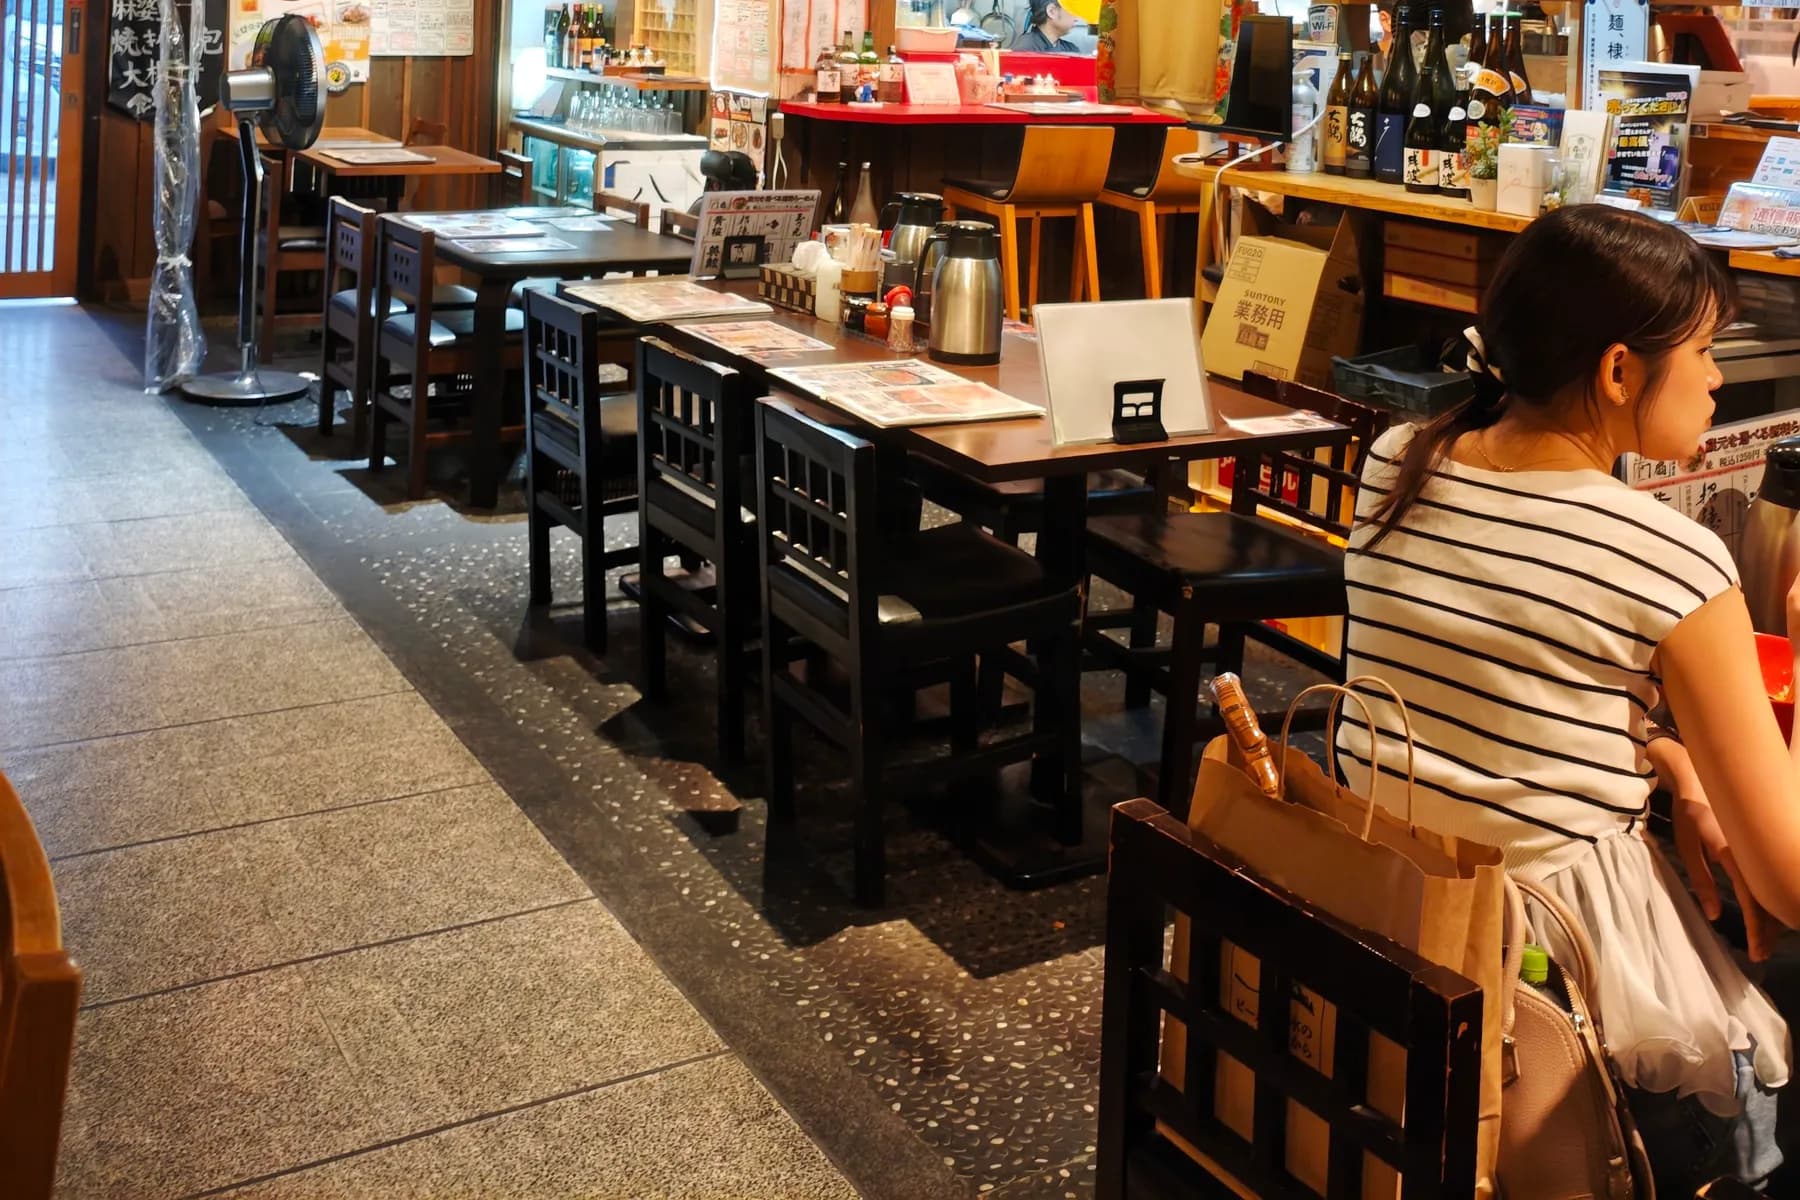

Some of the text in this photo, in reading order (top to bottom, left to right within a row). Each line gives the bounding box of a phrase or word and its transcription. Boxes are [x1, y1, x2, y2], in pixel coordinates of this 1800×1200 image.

[1312, 21, 1335, 31] Wi-Fi
[1233, 299, 1286, 331] 業務用
